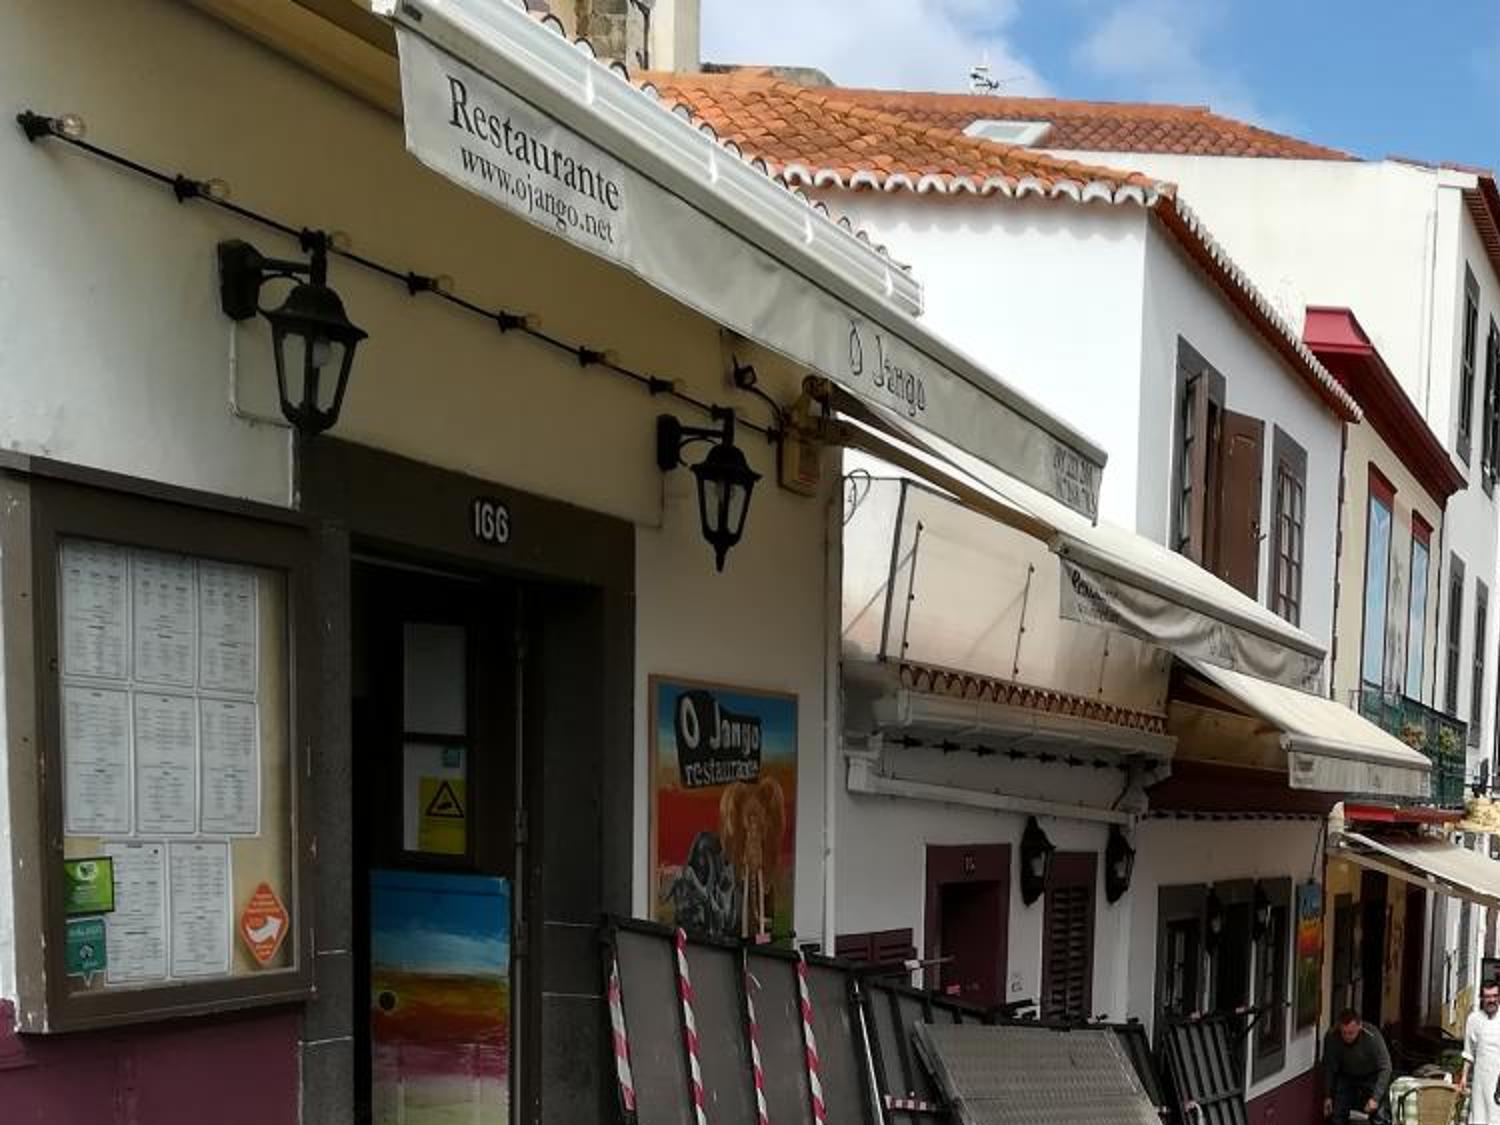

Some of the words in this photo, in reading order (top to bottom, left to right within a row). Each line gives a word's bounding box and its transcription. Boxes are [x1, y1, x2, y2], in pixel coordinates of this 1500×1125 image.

[448, 75, 619, 211] Restaurante
[461, 145, 613, 243] www.ojango.net
[475, 500, 509, 543] 166
[681, 697, 700, 748] O
[710, 702, 759, 753] Jango
